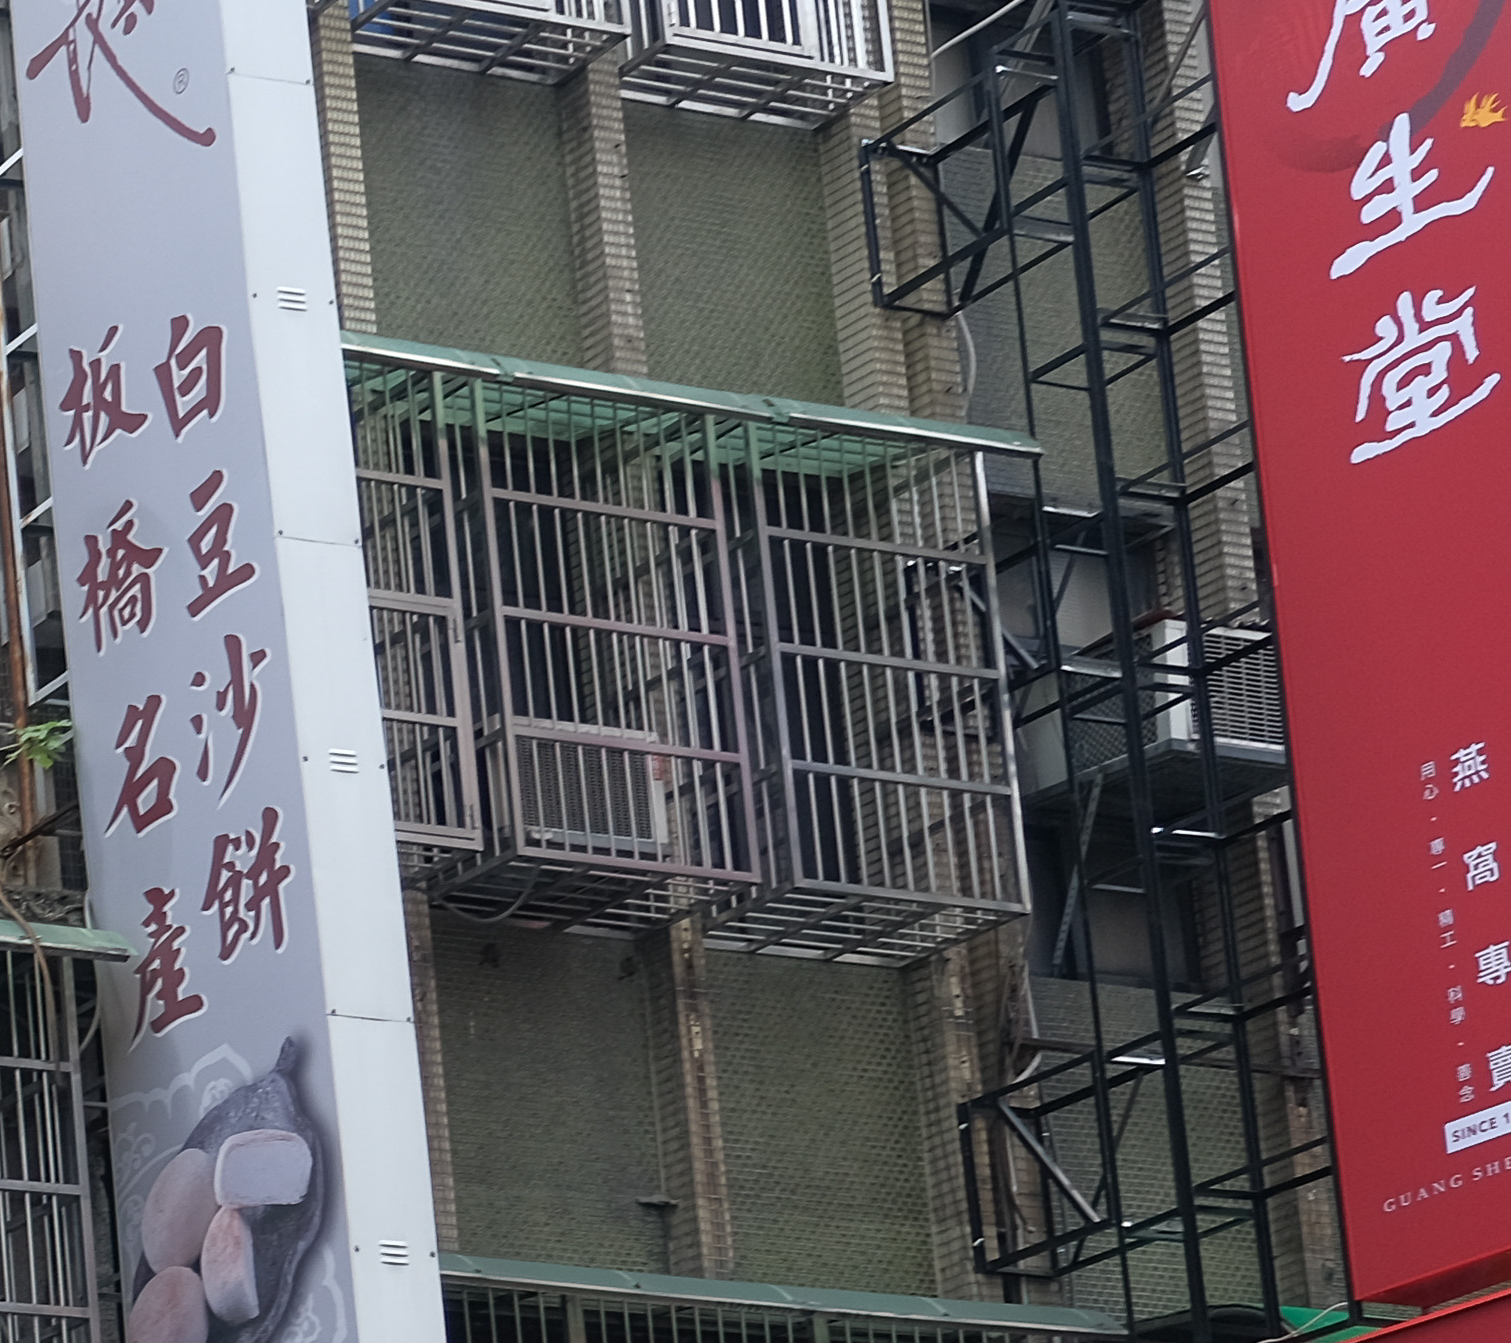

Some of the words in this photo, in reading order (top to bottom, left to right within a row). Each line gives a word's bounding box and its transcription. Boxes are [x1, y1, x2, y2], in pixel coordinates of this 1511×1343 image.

[56, 322, 207, 1048] 板橋名產
[152, 315, 297, 966] 白豆沙餅
[1383, 1169, 1464, 1213] GUANG
[1452, 1118, 1499, 1145] SINCE
